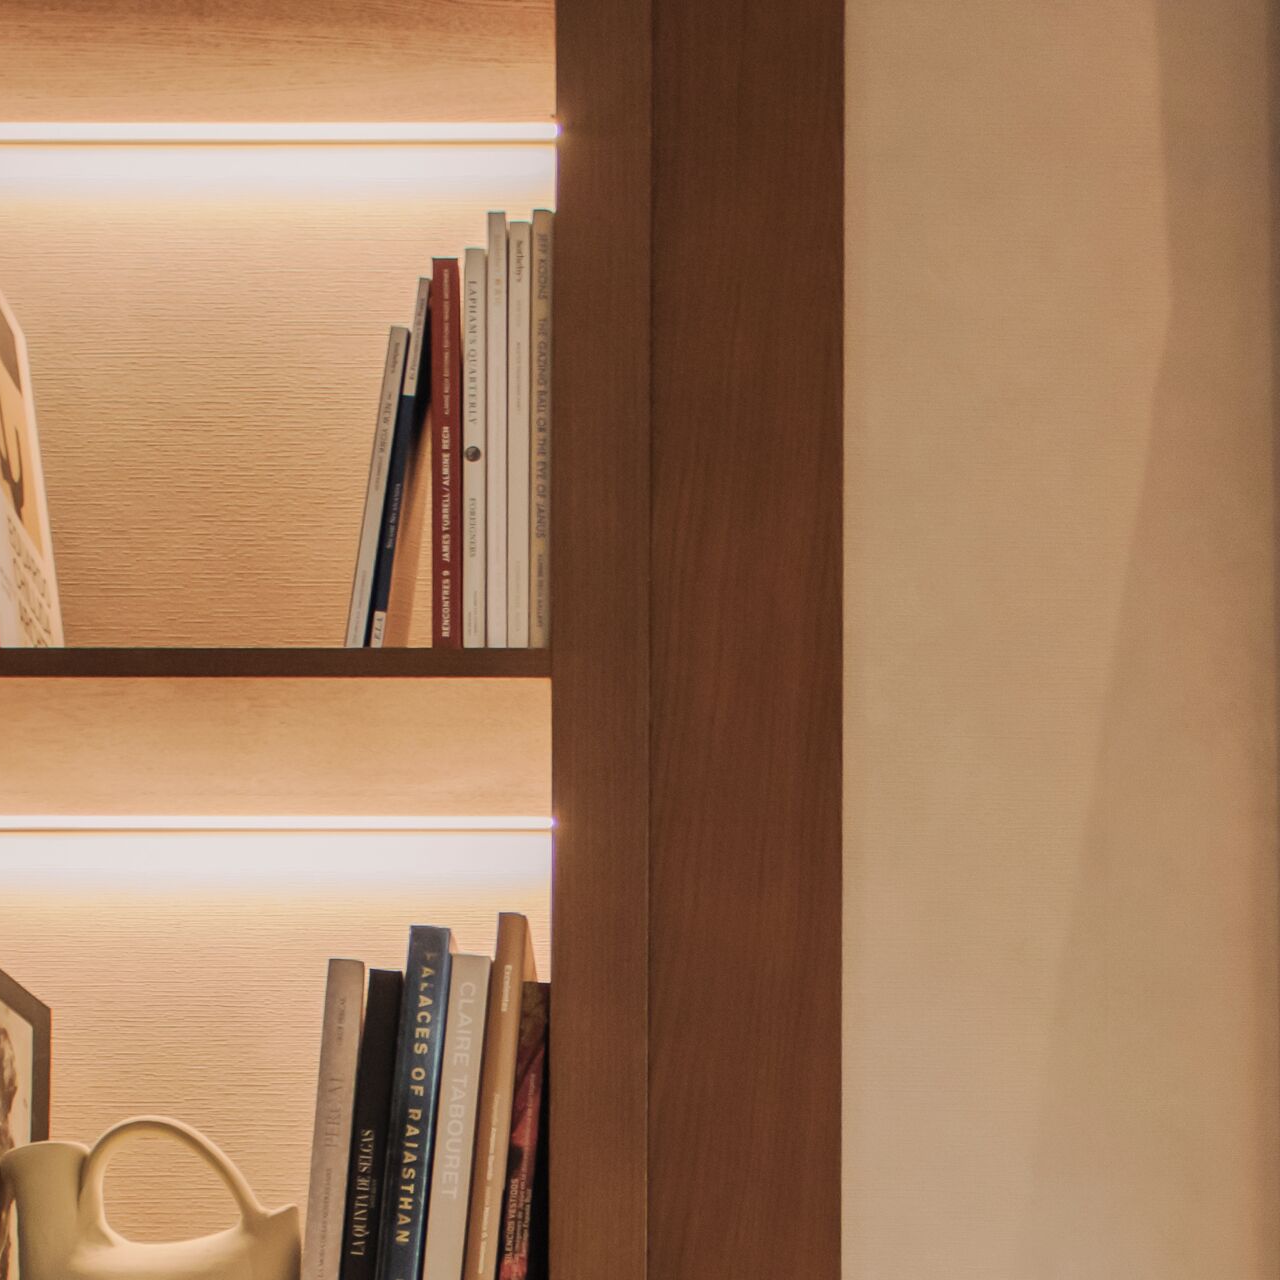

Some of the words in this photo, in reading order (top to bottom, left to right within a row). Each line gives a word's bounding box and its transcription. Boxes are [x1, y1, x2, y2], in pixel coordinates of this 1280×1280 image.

[537, 234, 549, 255] JEFF
[537, 259, 549, 301] KOONS
[468, 280, 478, 344] LAPHAM'S
[537, 318, 549, 337] THE
[537, 341, 549, 387] GAZING
[467, 348, 478, 425] QUARTERLY
[536, 438, 547, 457] THE
[536, 484, 547, 499] OF
[468, 497, 478, 558] FOREIGNERS
[536, 503, 548, 538] JANUS
[441, 533, 452, 563] JAMES
[441, 576, 452, 638] RENCONTRES
[452, 981, 477, 1067] CLAIRE
[409, 1067, 426, 1097] OF
[358, 1128, 375, 1174] SELGAS
[441, 1074, 469, 1200] TABOURET
[356, 1176, 372, 1191] DE
[394, 1107, 423, 1247] RAJASTHAN
[507, 1177, 519, 1218] VESTIDOS
[353, 1194, 371, 1238] QUINTA
[349, 1241, 366, 1257] LA
[503, 1220, 516, 1264] SILENCIOS
